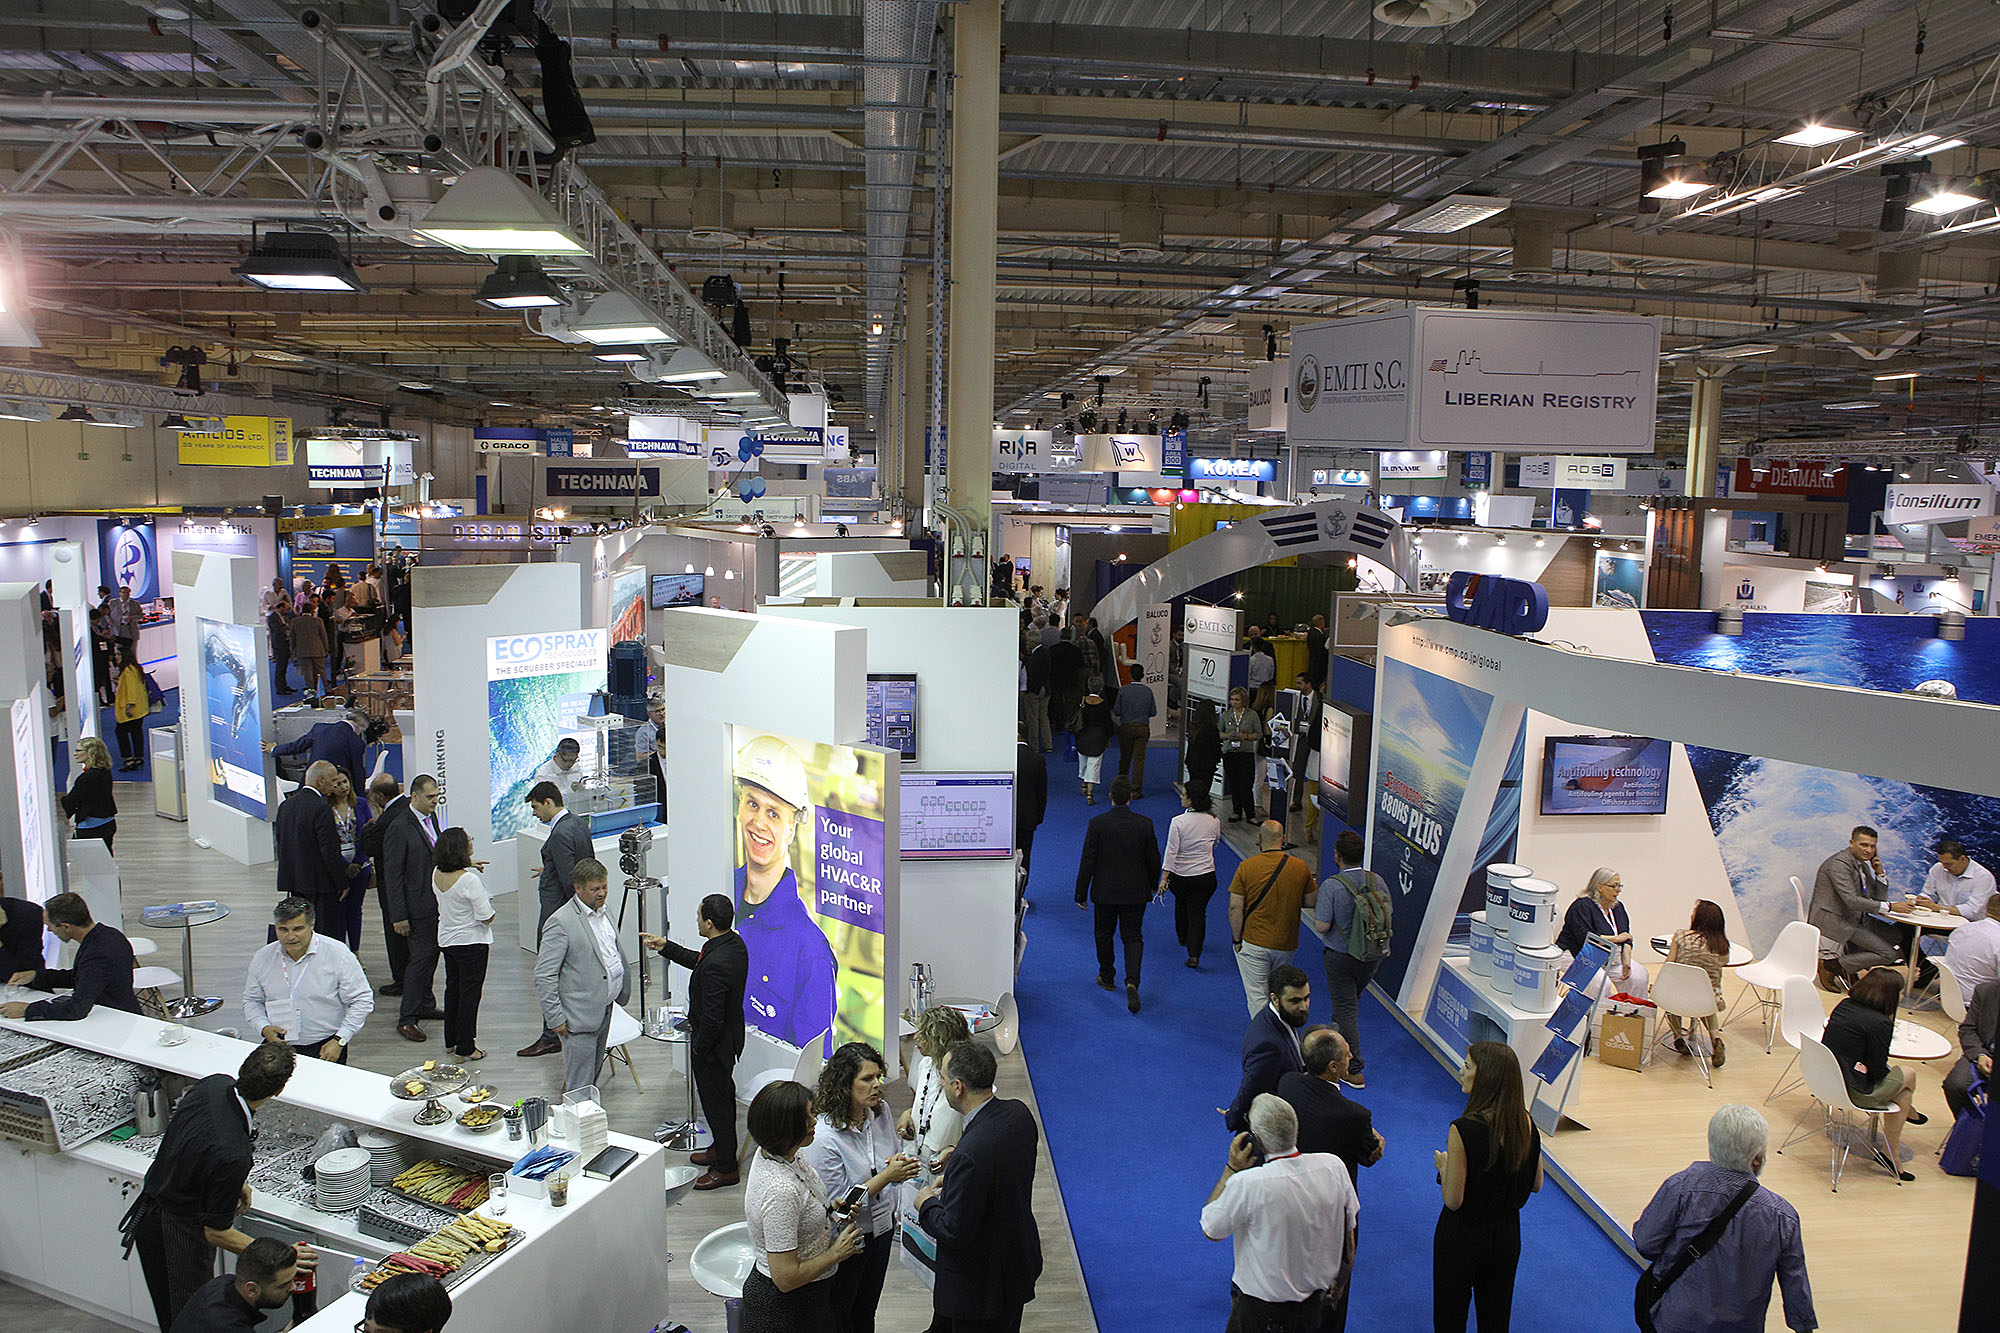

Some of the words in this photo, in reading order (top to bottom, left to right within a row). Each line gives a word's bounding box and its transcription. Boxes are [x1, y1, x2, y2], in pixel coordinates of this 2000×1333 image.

[1323, 363, 1369, 392] EMTI
[1373, 360, 1405, 390] S.C.
[1444, 390, 1534, 407] LIBERIAN
[1542, 393, 1637, 409] REGISTRY
[493, 442, 530, 450] GRACO
[630, 441, 677, 451] TECHNAVA
[309, 468, 362, 478] TECHNAVA
[1203, 462, 1260, 477] KOREA
[557, 474, 649, 490] TECHNAVA
[1770, 467, 1835, 489] DENMARK
[1896, 493, 1981, 509] Consilium
[452, 524, 521, 542] DESAN
[1974, 533, 2000, 542] EMER
[1146, 609, 1169, 619] BALUCO
[1199, 620, 1220, 633] EMTI
[1221, 623, 1235, 635] S.C.
[544, 648, 597, 660] TECHNOLOGIES
[496, 667, 511, 675] THE
[513, 662, 554, 674] SCRUBBER
[556, 659, 597, 670] SPECIALIST
[1145, 651, 1165, 675] 20
[1200, 657, 1215, 677] 70
[1145, 675, 1164, 684] YEARS
[436, 729, 447, 805] OCEANKING
[1557, 765, 1611, 780] Antifouling
[1611, 765, 1663, 780] technology
[1568, 790, 1603, 798] Antifouling
[1635, 789, 1660, 797] fishnets
[820, 816, 854, 839] Your
[1381, 791, 1410, 825] 880HS
[1407, 808, 1443, 856] PLUS
[820, 841, 863, 866] global
[820, 862, 882, 896] HVAC&R
[820, 889, 874, 916] partner
[1511, 908, 1530, 921] PLUS
[1604, 1041, 1635, 1052] adidas
